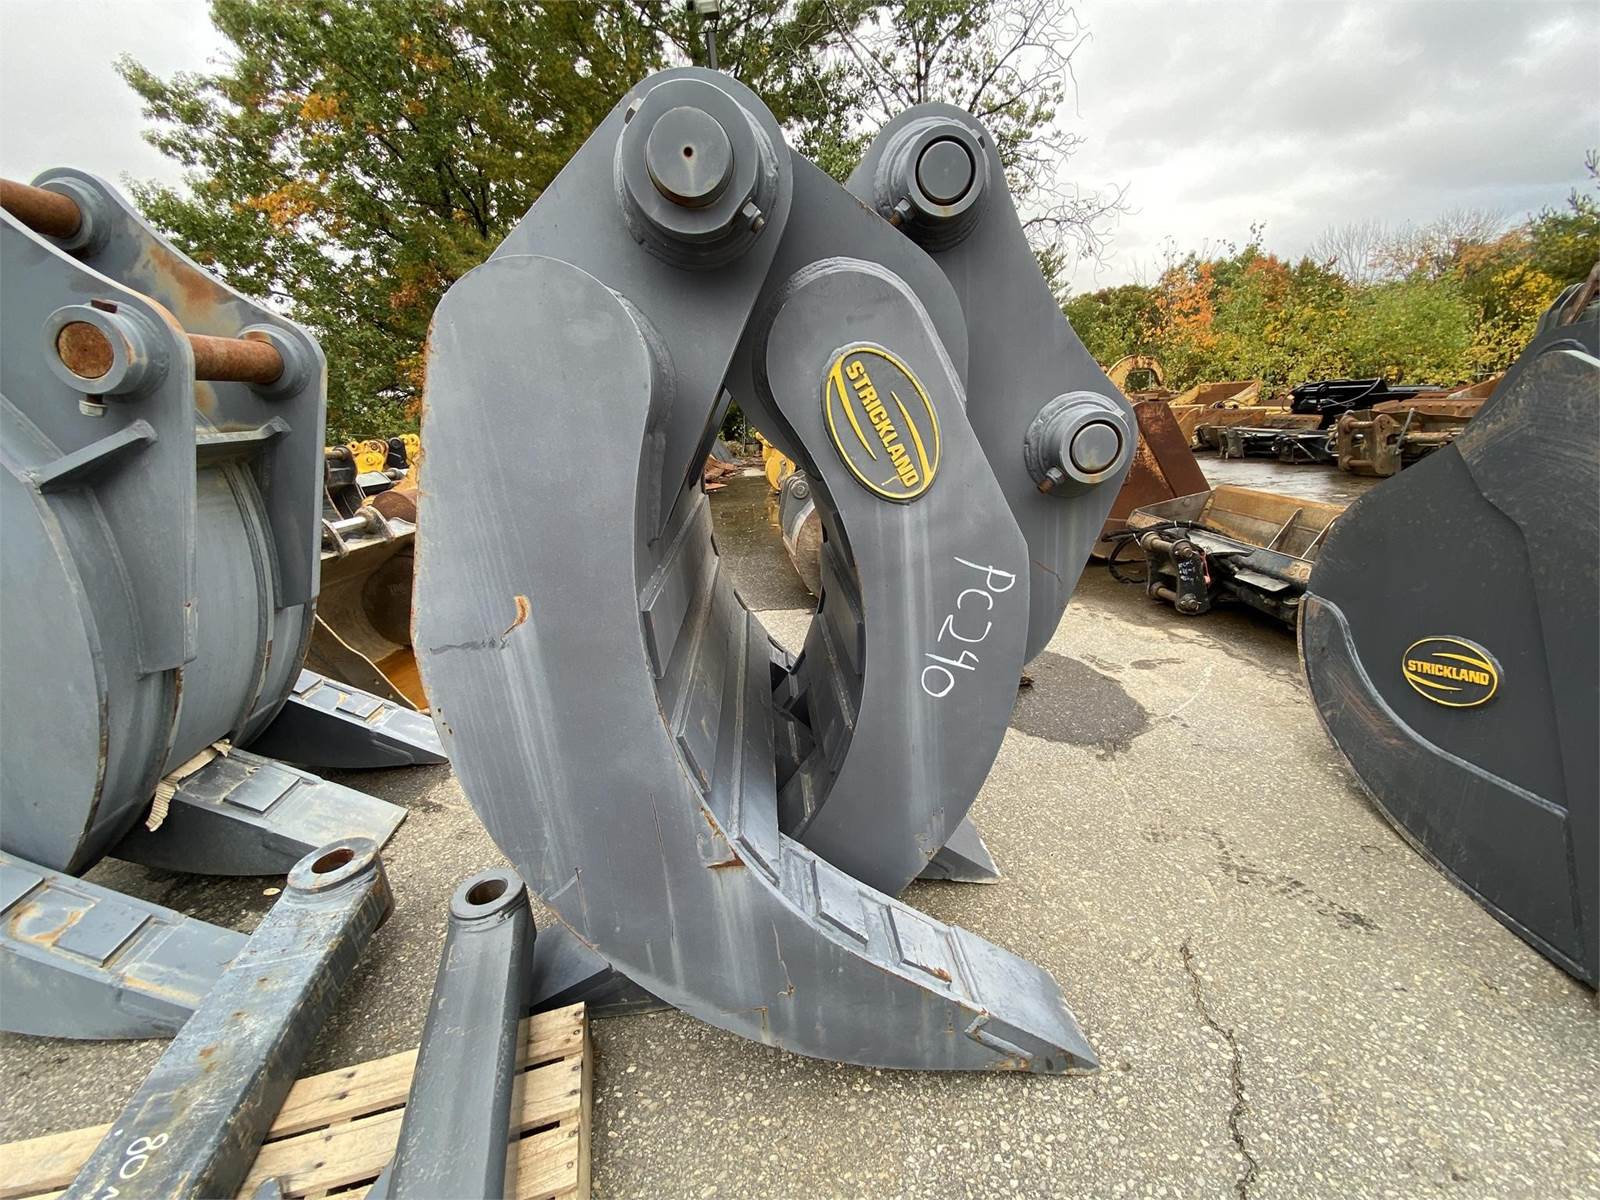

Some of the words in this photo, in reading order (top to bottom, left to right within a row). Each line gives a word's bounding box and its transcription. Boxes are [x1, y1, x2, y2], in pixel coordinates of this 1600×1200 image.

[846, 360, 919, 487] STRICKLAND
[921, 556, 1016, 697] PC240
[1407, 659, 1490, 686] STRICKLAND
